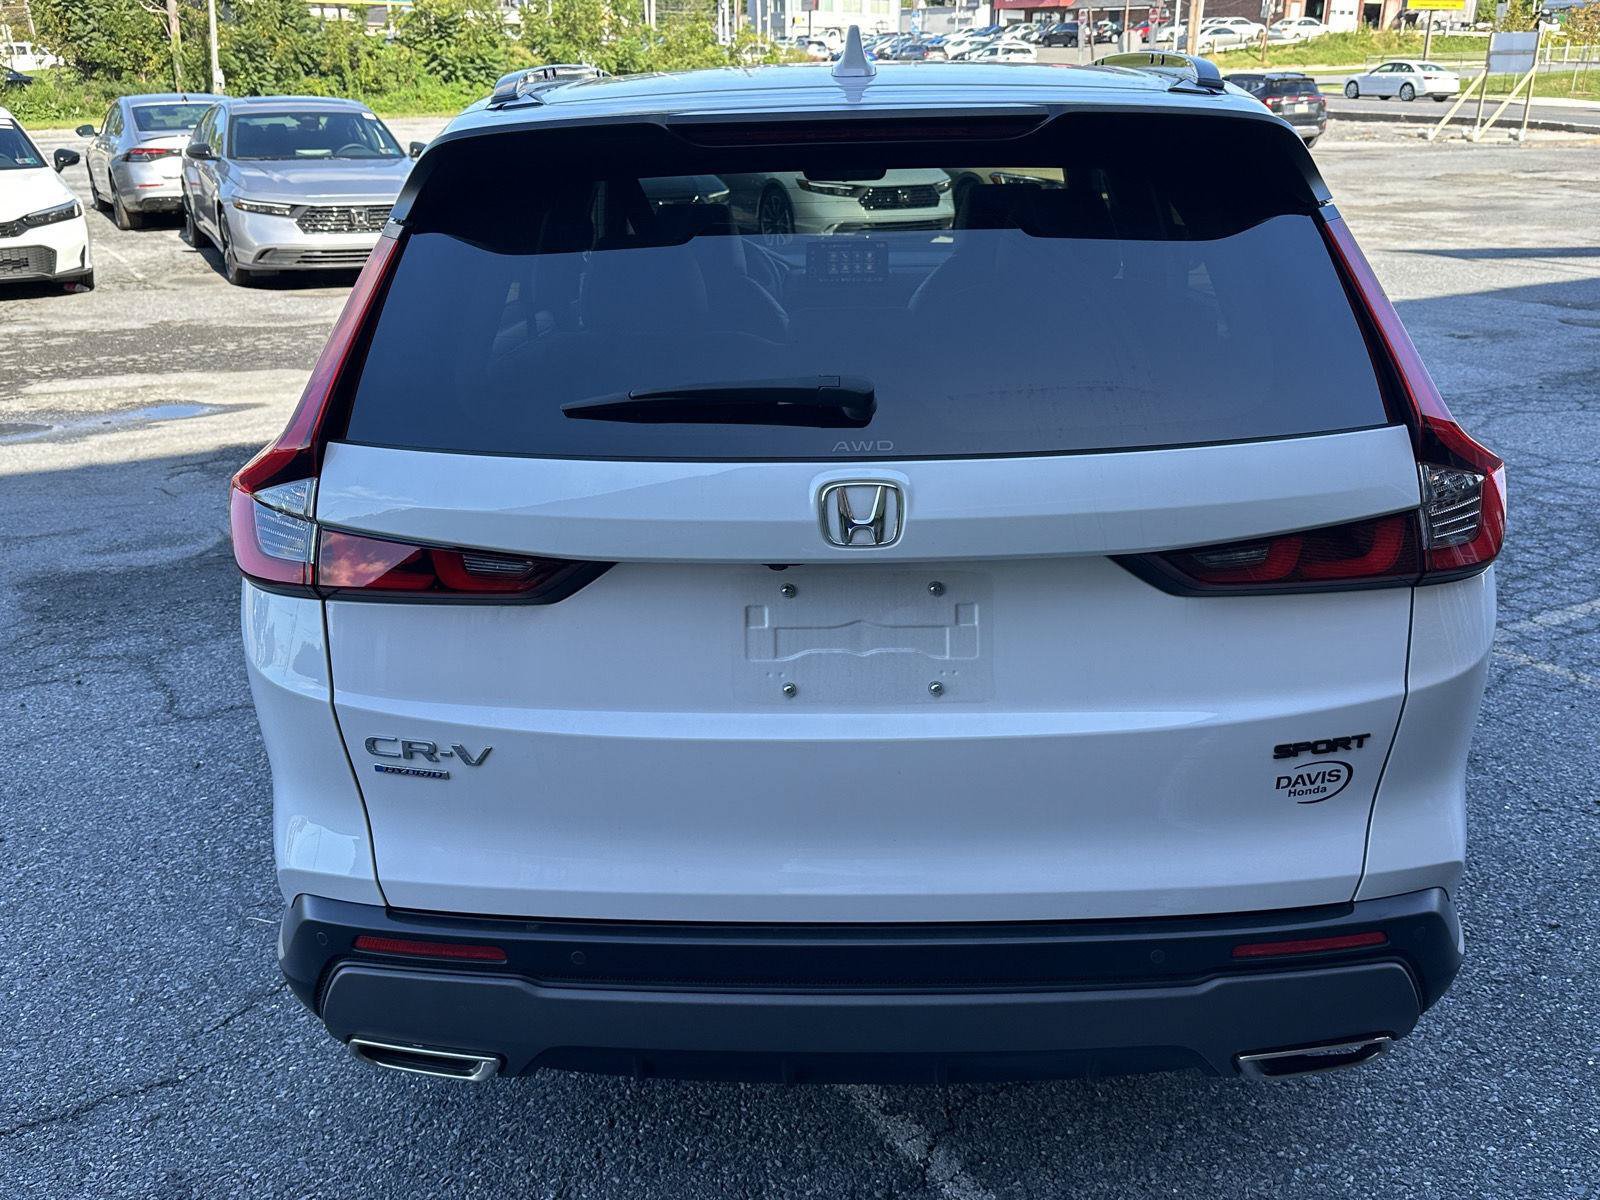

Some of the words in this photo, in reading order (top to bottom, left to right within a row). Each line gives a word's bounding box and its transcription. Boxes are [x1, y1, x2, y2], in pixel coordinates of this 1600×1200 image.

[831, 440, 894, 452] AWD
[365, 736, 493, 766] CR-V
[1273, 733, 1371, 759] SPORT
[1275, 768, 1342, 790] DAVIS
[1287, 785, 1327, 798] Honda
